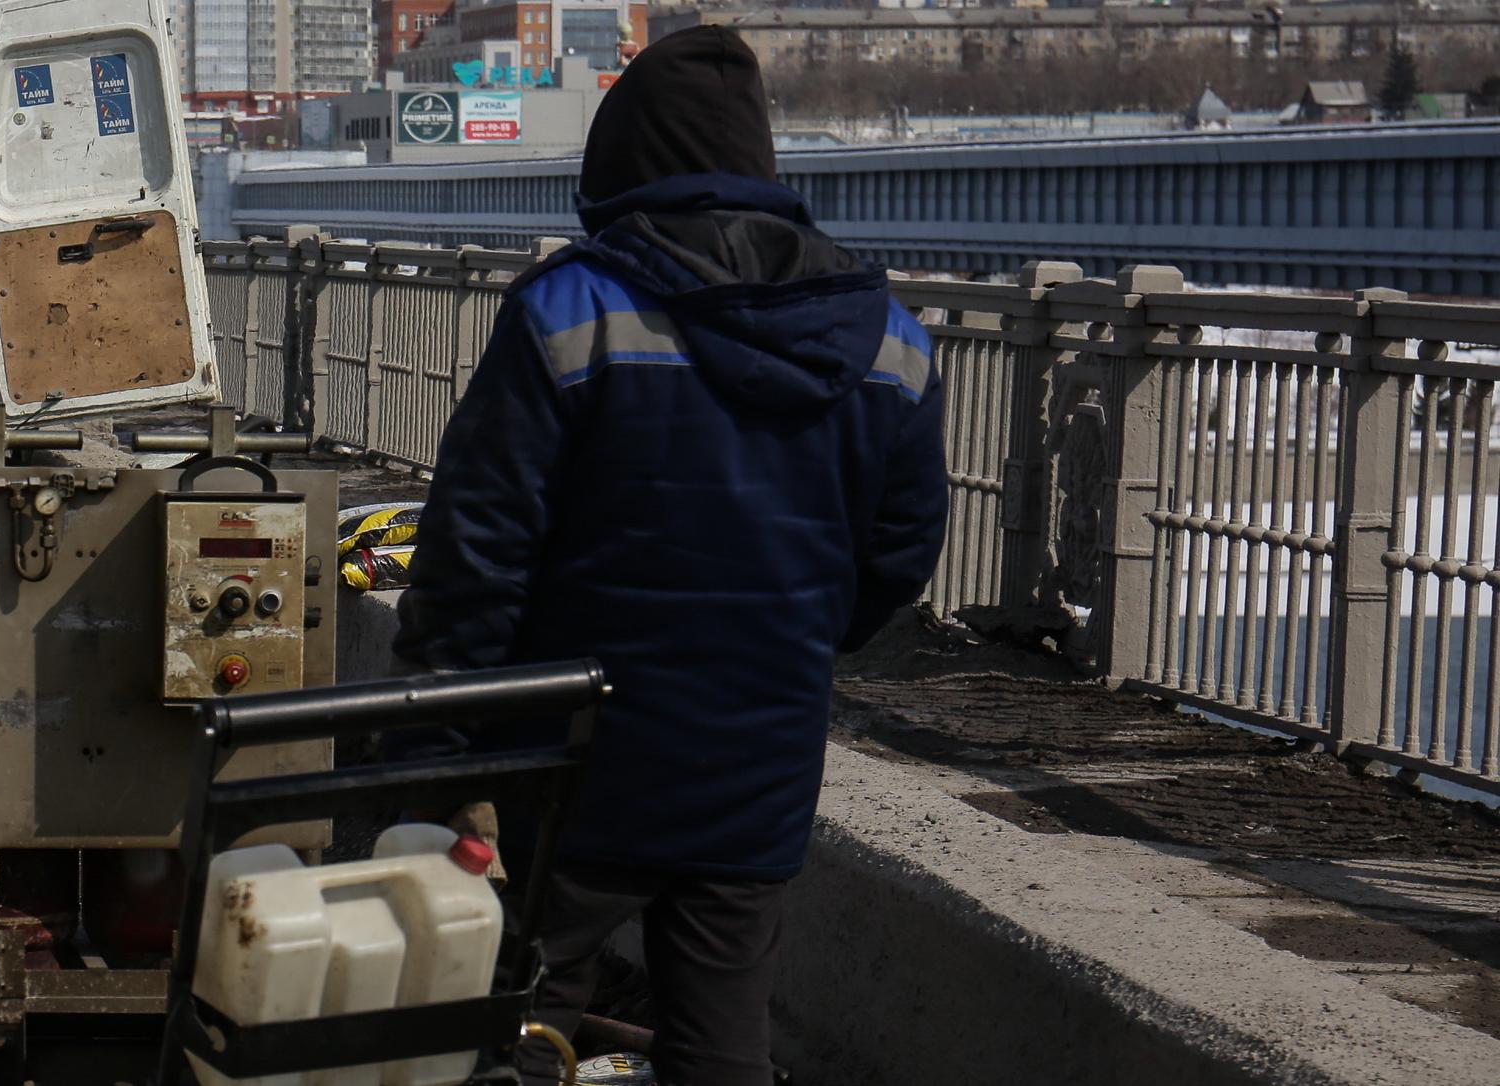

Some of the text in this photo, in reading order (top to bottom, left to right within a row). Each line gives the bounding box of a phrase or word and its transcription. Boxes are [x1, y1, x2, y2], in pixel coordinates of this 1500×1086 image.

[489, 66, 553, 85] РЕКА
[97, 78, 125, 89] ТАЙМ
[21, 88, 49, 100] ТАЙМ
[402, 113, 453, 122] PRIMETIME
[103, 118, 130, 129] ТАЙМ
